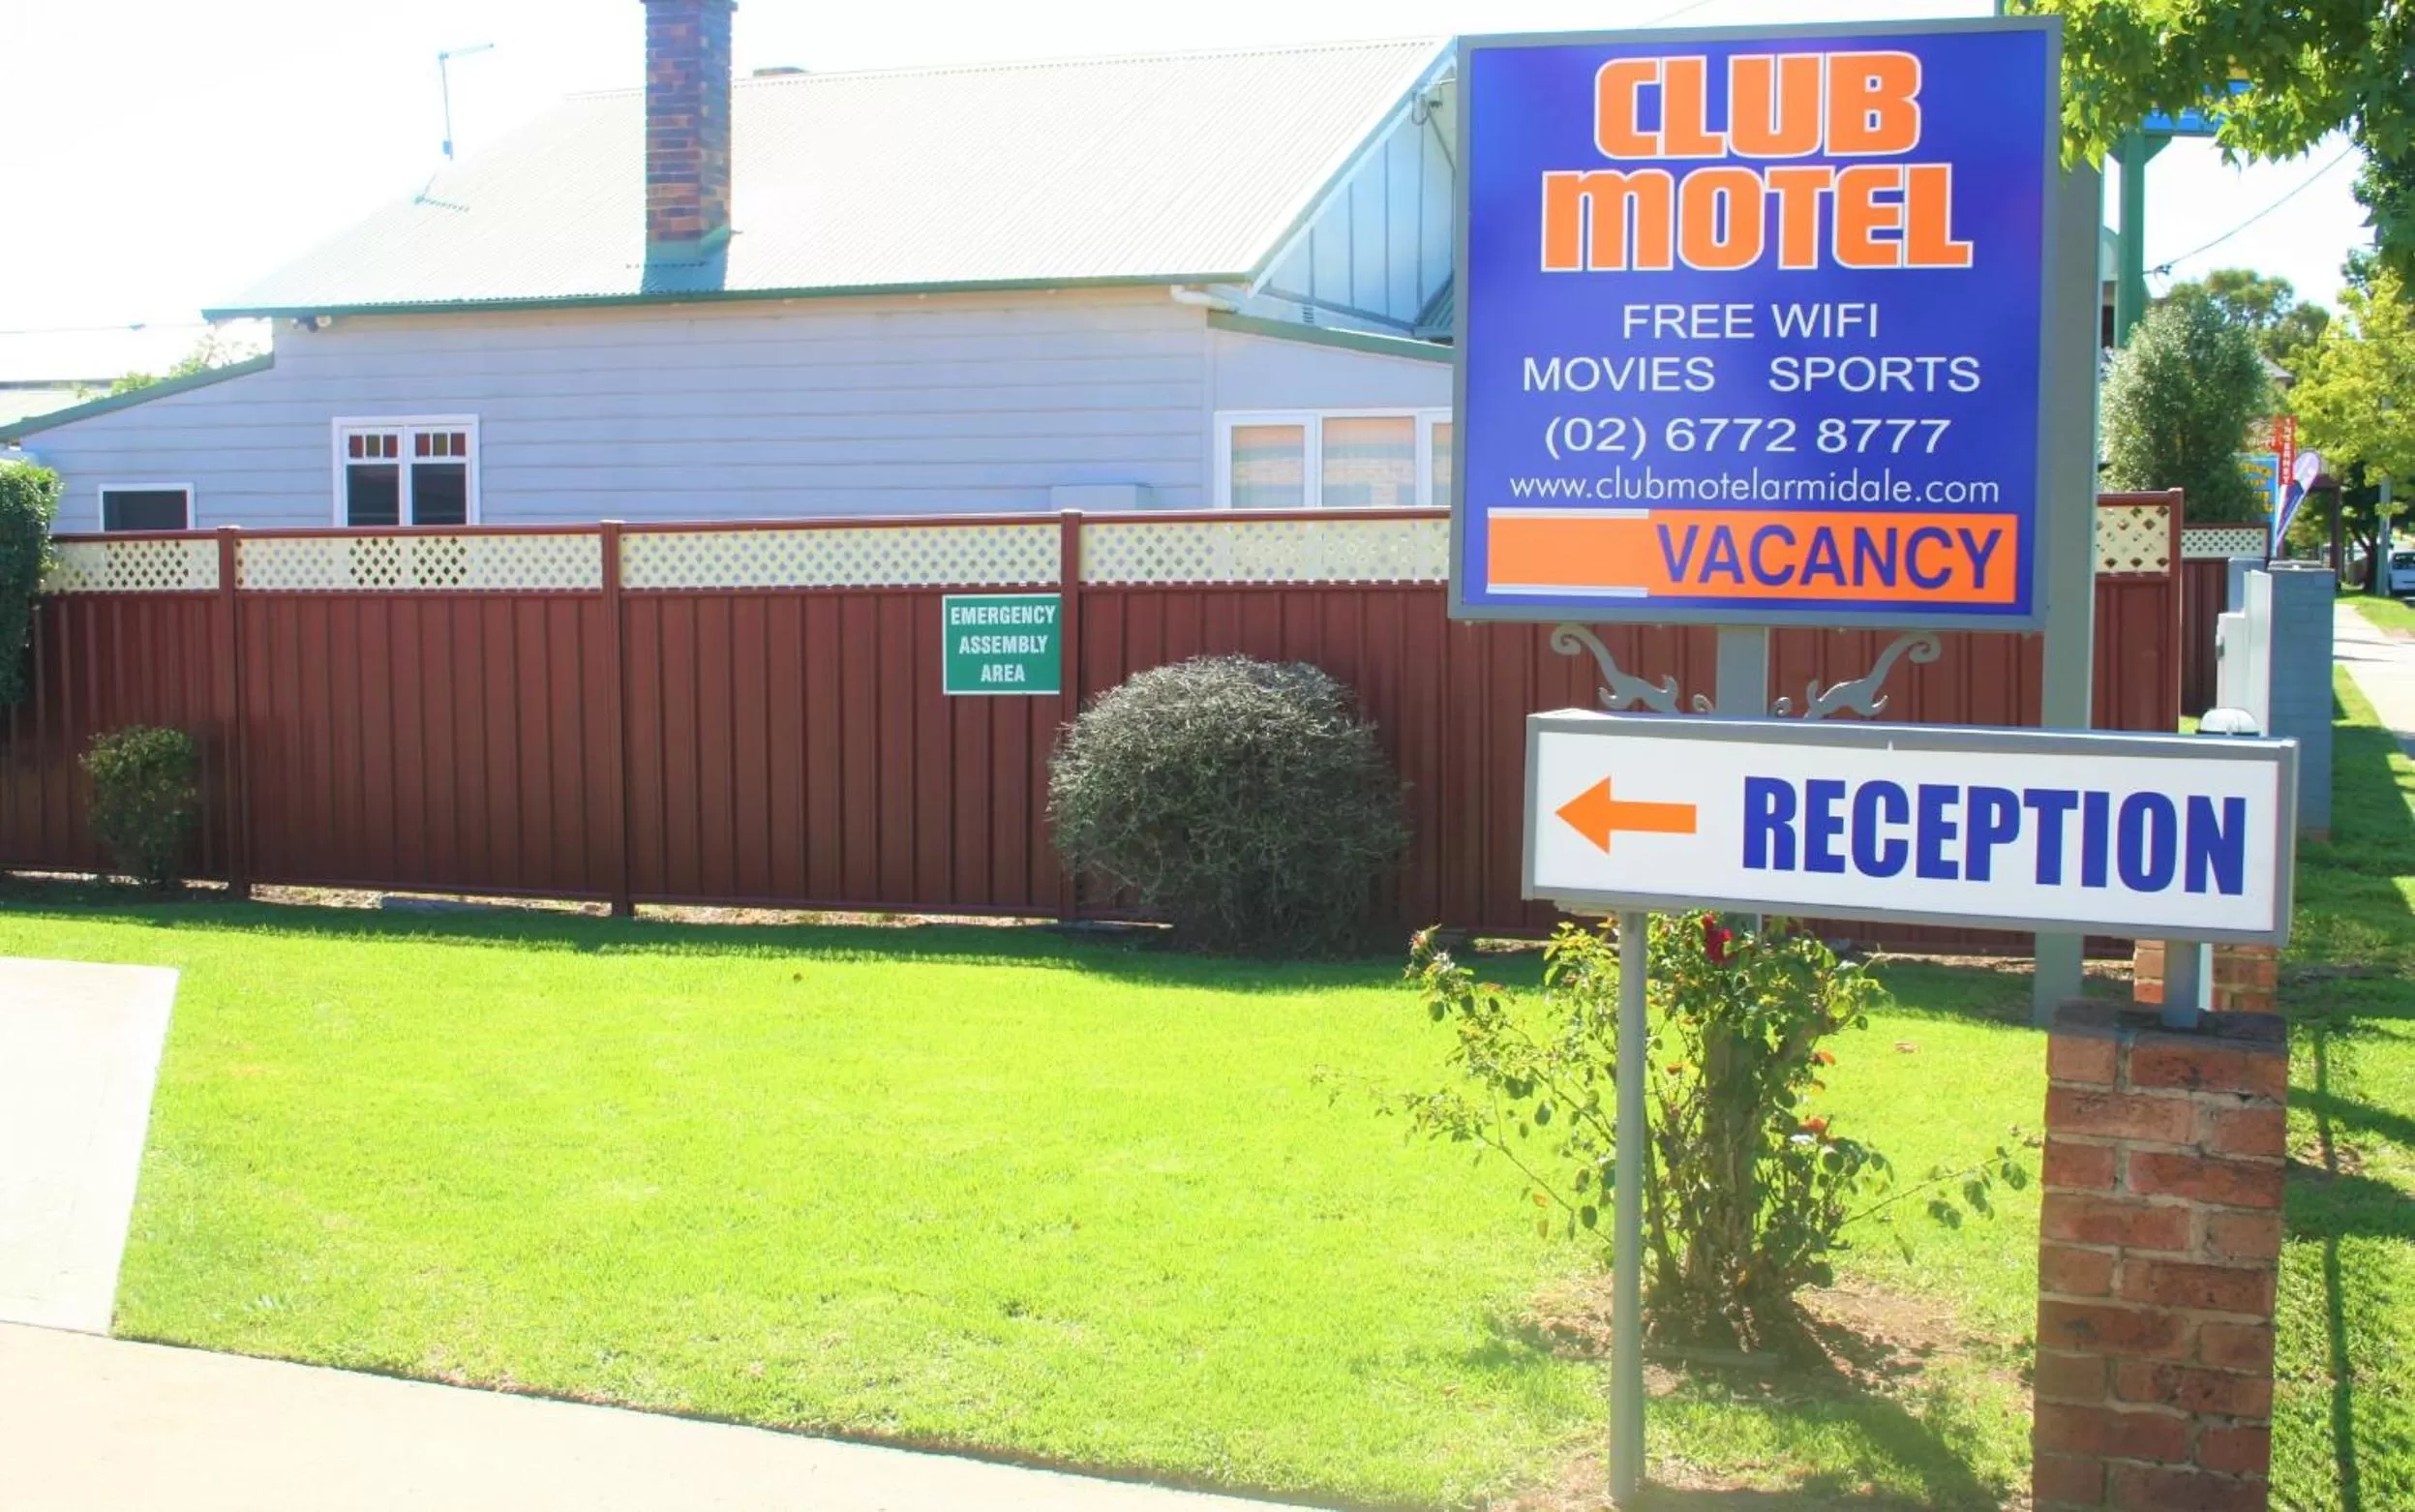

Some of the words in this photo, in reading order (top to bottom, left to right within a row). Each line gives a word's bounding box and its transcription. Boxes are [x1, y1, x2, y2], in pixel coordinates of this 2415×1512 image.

[1594, 50, 1922, 160] CLUB
[1541, 163, 1974, 273] MOTEL
[1623, 303, 1755, 339] FREE
[1770, 302, 1879, 339] WIFI
[1523, 355, 1716, 393] MOVIES
[1768, 355, 1981, 393] SPORTS
[1545, 417, 1646, 461] (02)
[1665, 418, 1796, 454] 6772
[1816, 417, 1952, 454] 8777
[1510, 466, 2001, 504] www.clubmotelarmidale.com
[1656, 523, 2004, 590] VACANCY
[951, 605, 1056, 625] EMERGENCY
[958, 635, 1048, 654] ASSEMBLY
[981, 664, 1026, 682] AREA
[1742, 775, 2247, 896] RECEPTION
